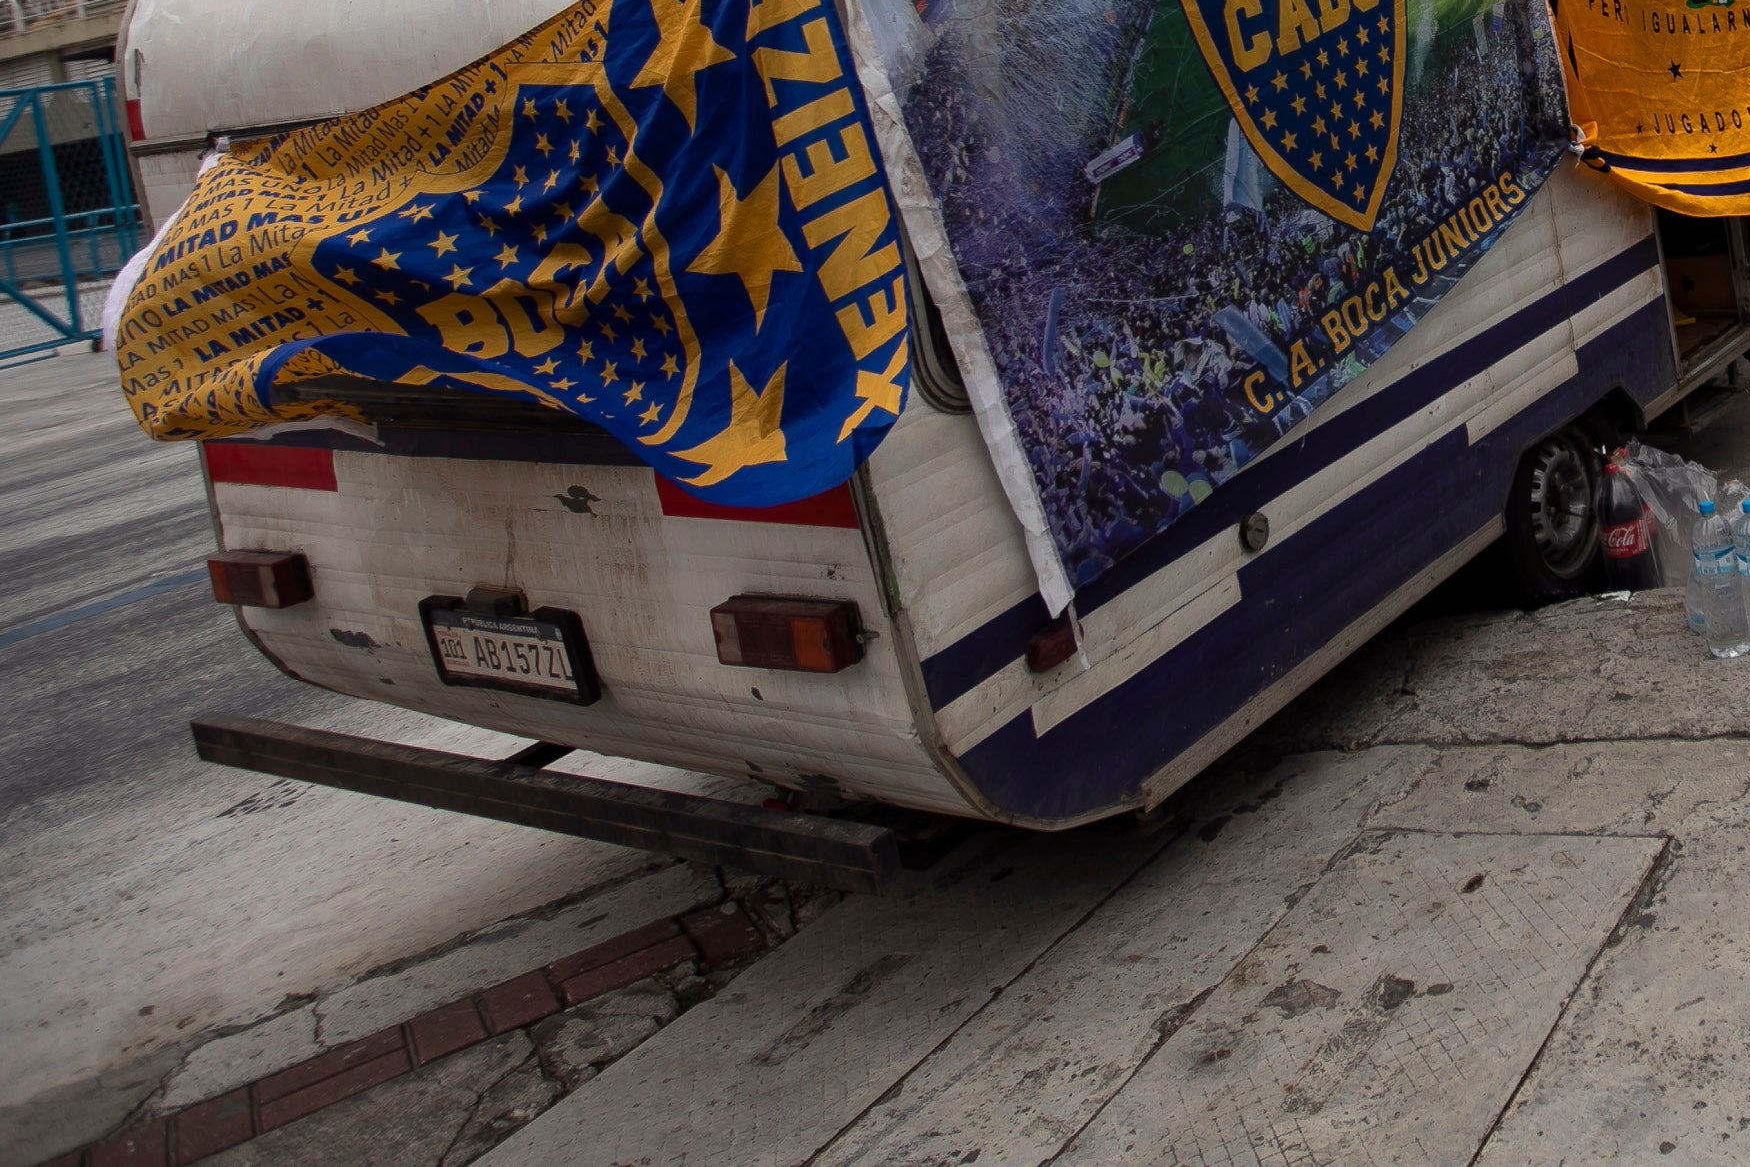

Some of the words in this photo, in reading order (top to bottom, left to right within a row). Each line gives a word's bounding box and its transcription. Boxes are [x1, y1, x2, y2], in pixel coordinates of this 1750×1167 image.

[305, 181, 390, 213] Mitad
[427, 142, 452, 168] LA
[446, 92, 486, 147] MITAD
[316, 145, 343, 168] La
[344, 134, 388, 178] Mitad
[377, 110, 409, 142] Mas
[371, 131, 423, 186] Mitad
[435, 94, 458, 118] LA
[153, 220, 239, 274] MITAD
[246, 212, 327, 232] MAS
[163, 263, 200, 292] MAS
[218, 244, 243, 269] La
[161, 297, 193, 318] LA
[191, 270, 251, 304] MITAD
[415, 193, 644, 359] BOCA
[1244, 370, 1284, 414] C.
[1291, 339, 1326, 388] A.
[1321, 266, 1410, 354] BOCA
[1411, 171, 1526, 285] JUNIORS
[119, 351, 146, 372] LA
[146, 318, 210, 355] MITAD
[210, 295, 257, 327] MAS
[260, 283, 299, 306] La
[193, 339, 232, 364] LA
[228, 306, 306, 348] MITAD
[1608, 525, 1636, 547] Cola
[440, 638, 467, 660] 101
